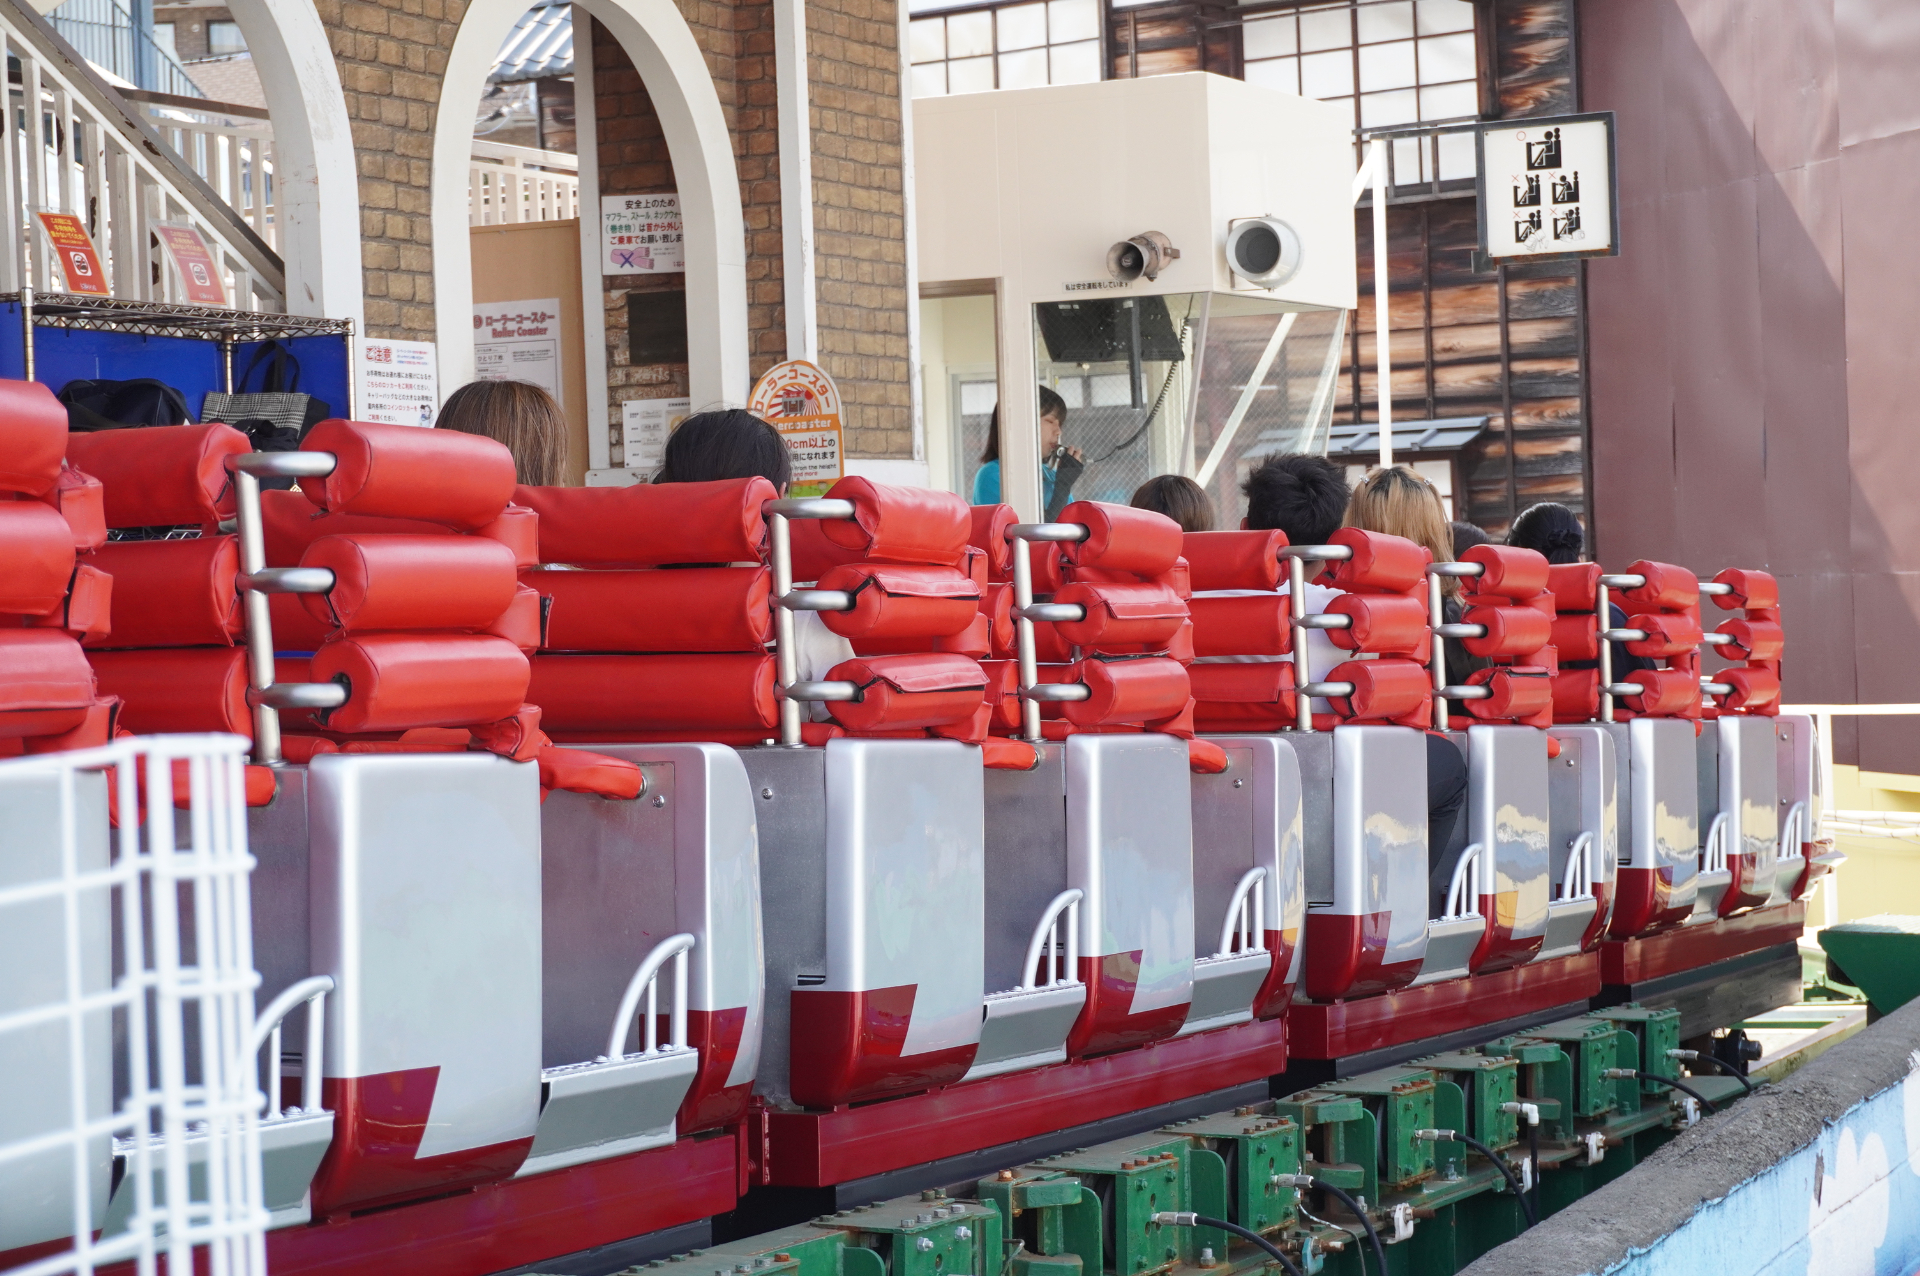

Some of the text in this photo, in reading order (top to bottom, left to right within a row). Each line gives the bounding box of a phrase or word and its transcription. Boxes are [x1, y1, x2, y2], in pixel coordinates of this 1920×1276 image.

[625, 199, 676, 210] 安全上のため
[485, 311, 555, 327] ローラーコースター
[492, 326, 548, 339] Roller Coaster
[366, 347, 391, 364] ご注意
[755, 369, 830, 412] ローラーコースター
